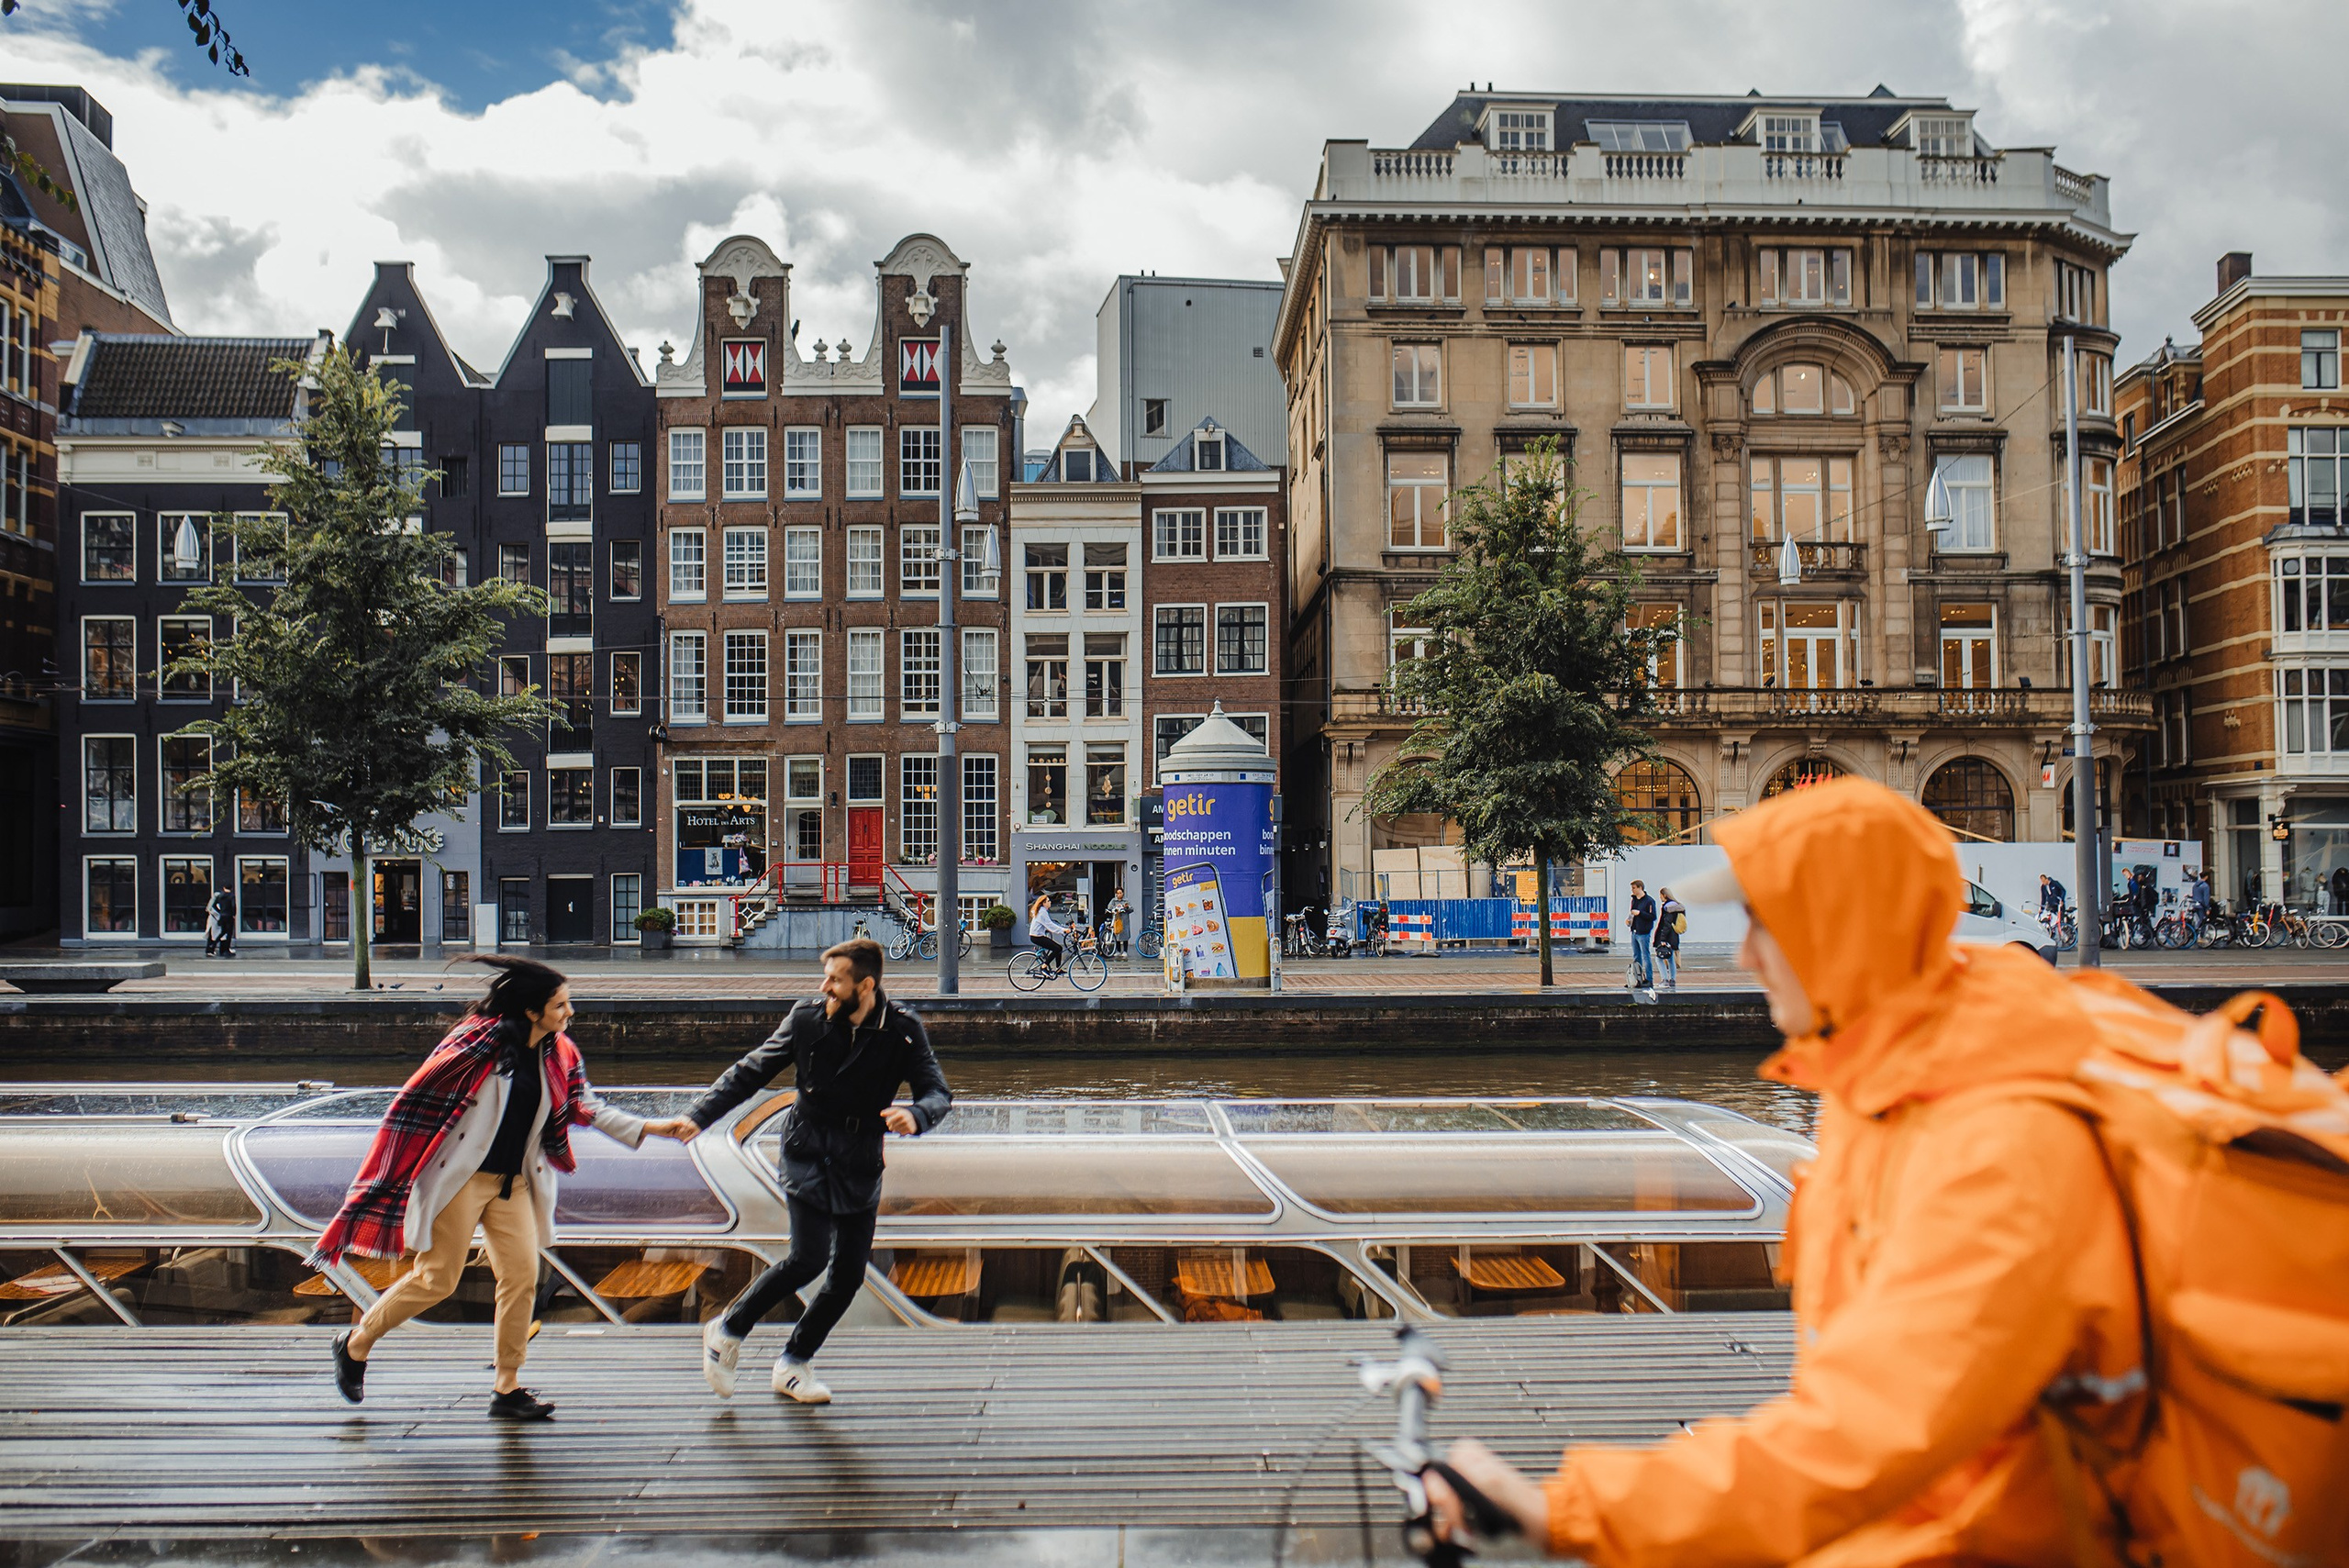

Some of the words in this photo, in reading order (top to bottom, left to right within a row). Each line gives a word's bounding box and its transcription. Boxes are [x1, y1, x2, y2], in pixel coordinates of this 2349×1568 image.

[1167, 793, 1216, 822] getir
[687, 815, 719, 826] HOTEL
[730, 815, 755, 826] ARTS
[1025, 842, 1080, 851] SHANGHAI
[1082, 843, 1128, 851] NOODLE
[1185, 844, 1236, 856] minuten
[1172, 871, 1194, 889] getir
